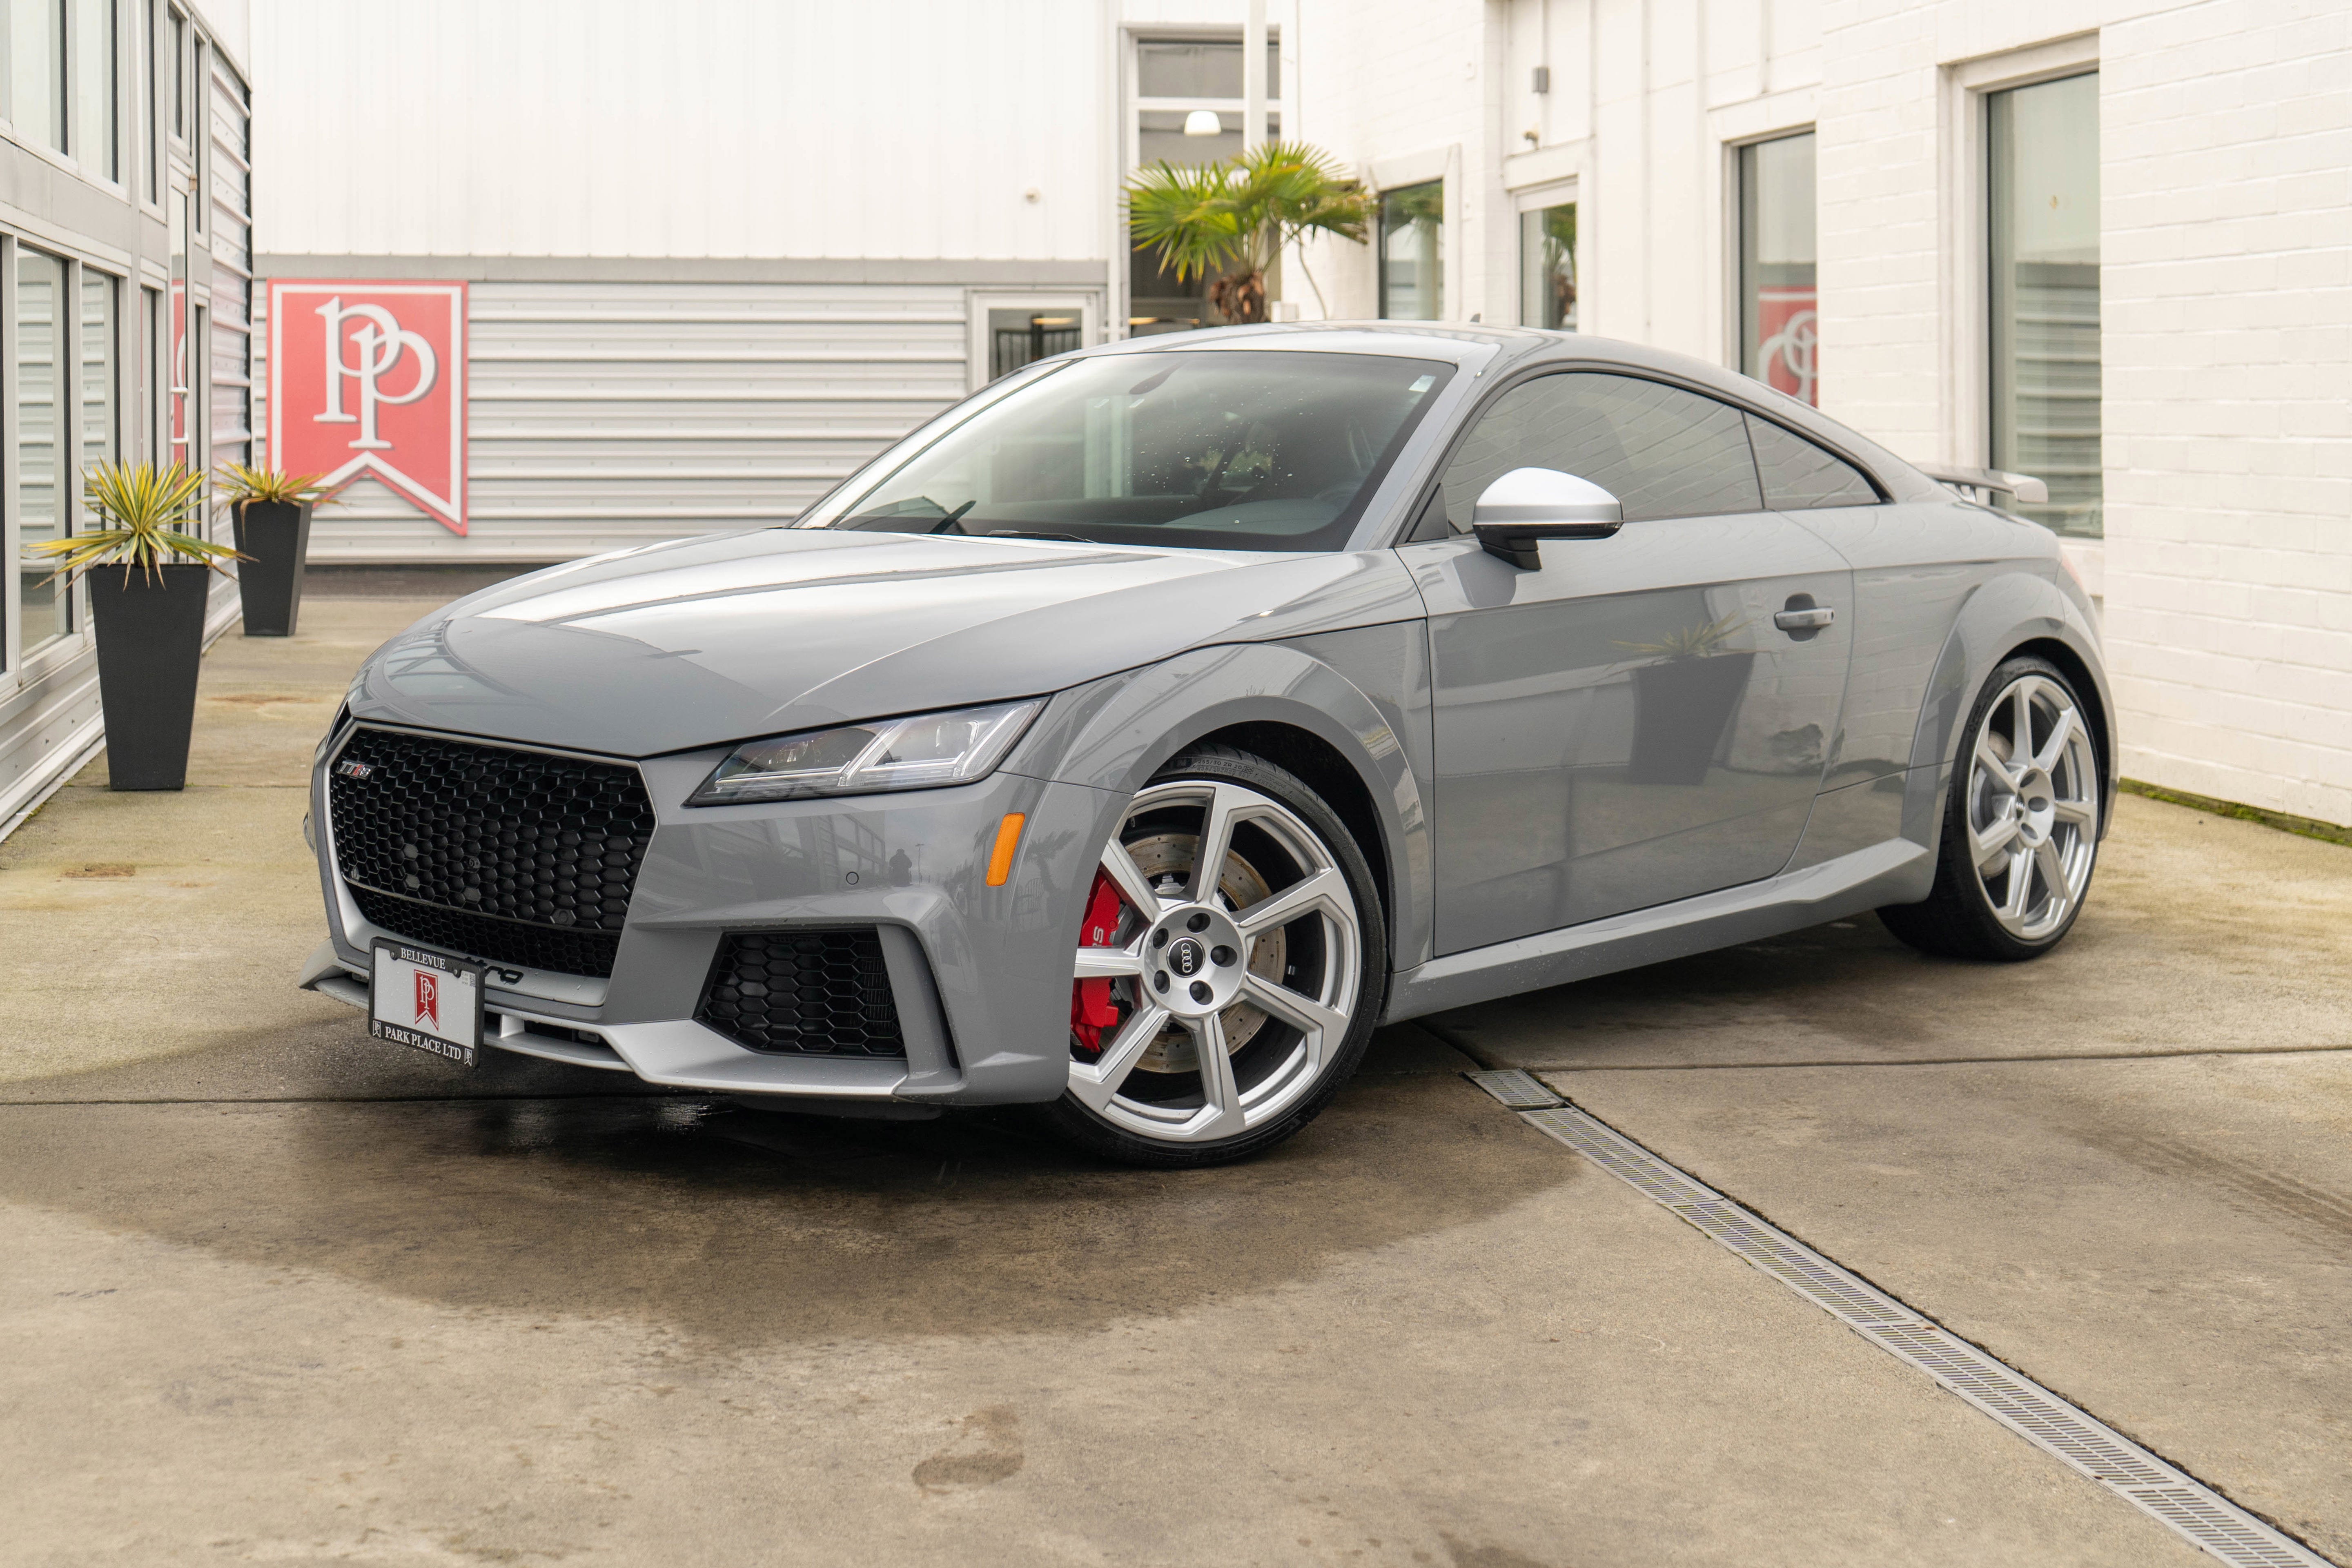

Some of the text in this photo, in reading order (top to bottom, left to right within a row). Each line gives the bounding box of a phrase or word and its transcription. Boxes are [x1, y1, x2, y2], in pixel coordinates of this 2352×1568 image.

[401, 948, 446, 969] BELLEVUE
[385, 1026, 461, 1060] PARK PLACE LTD
